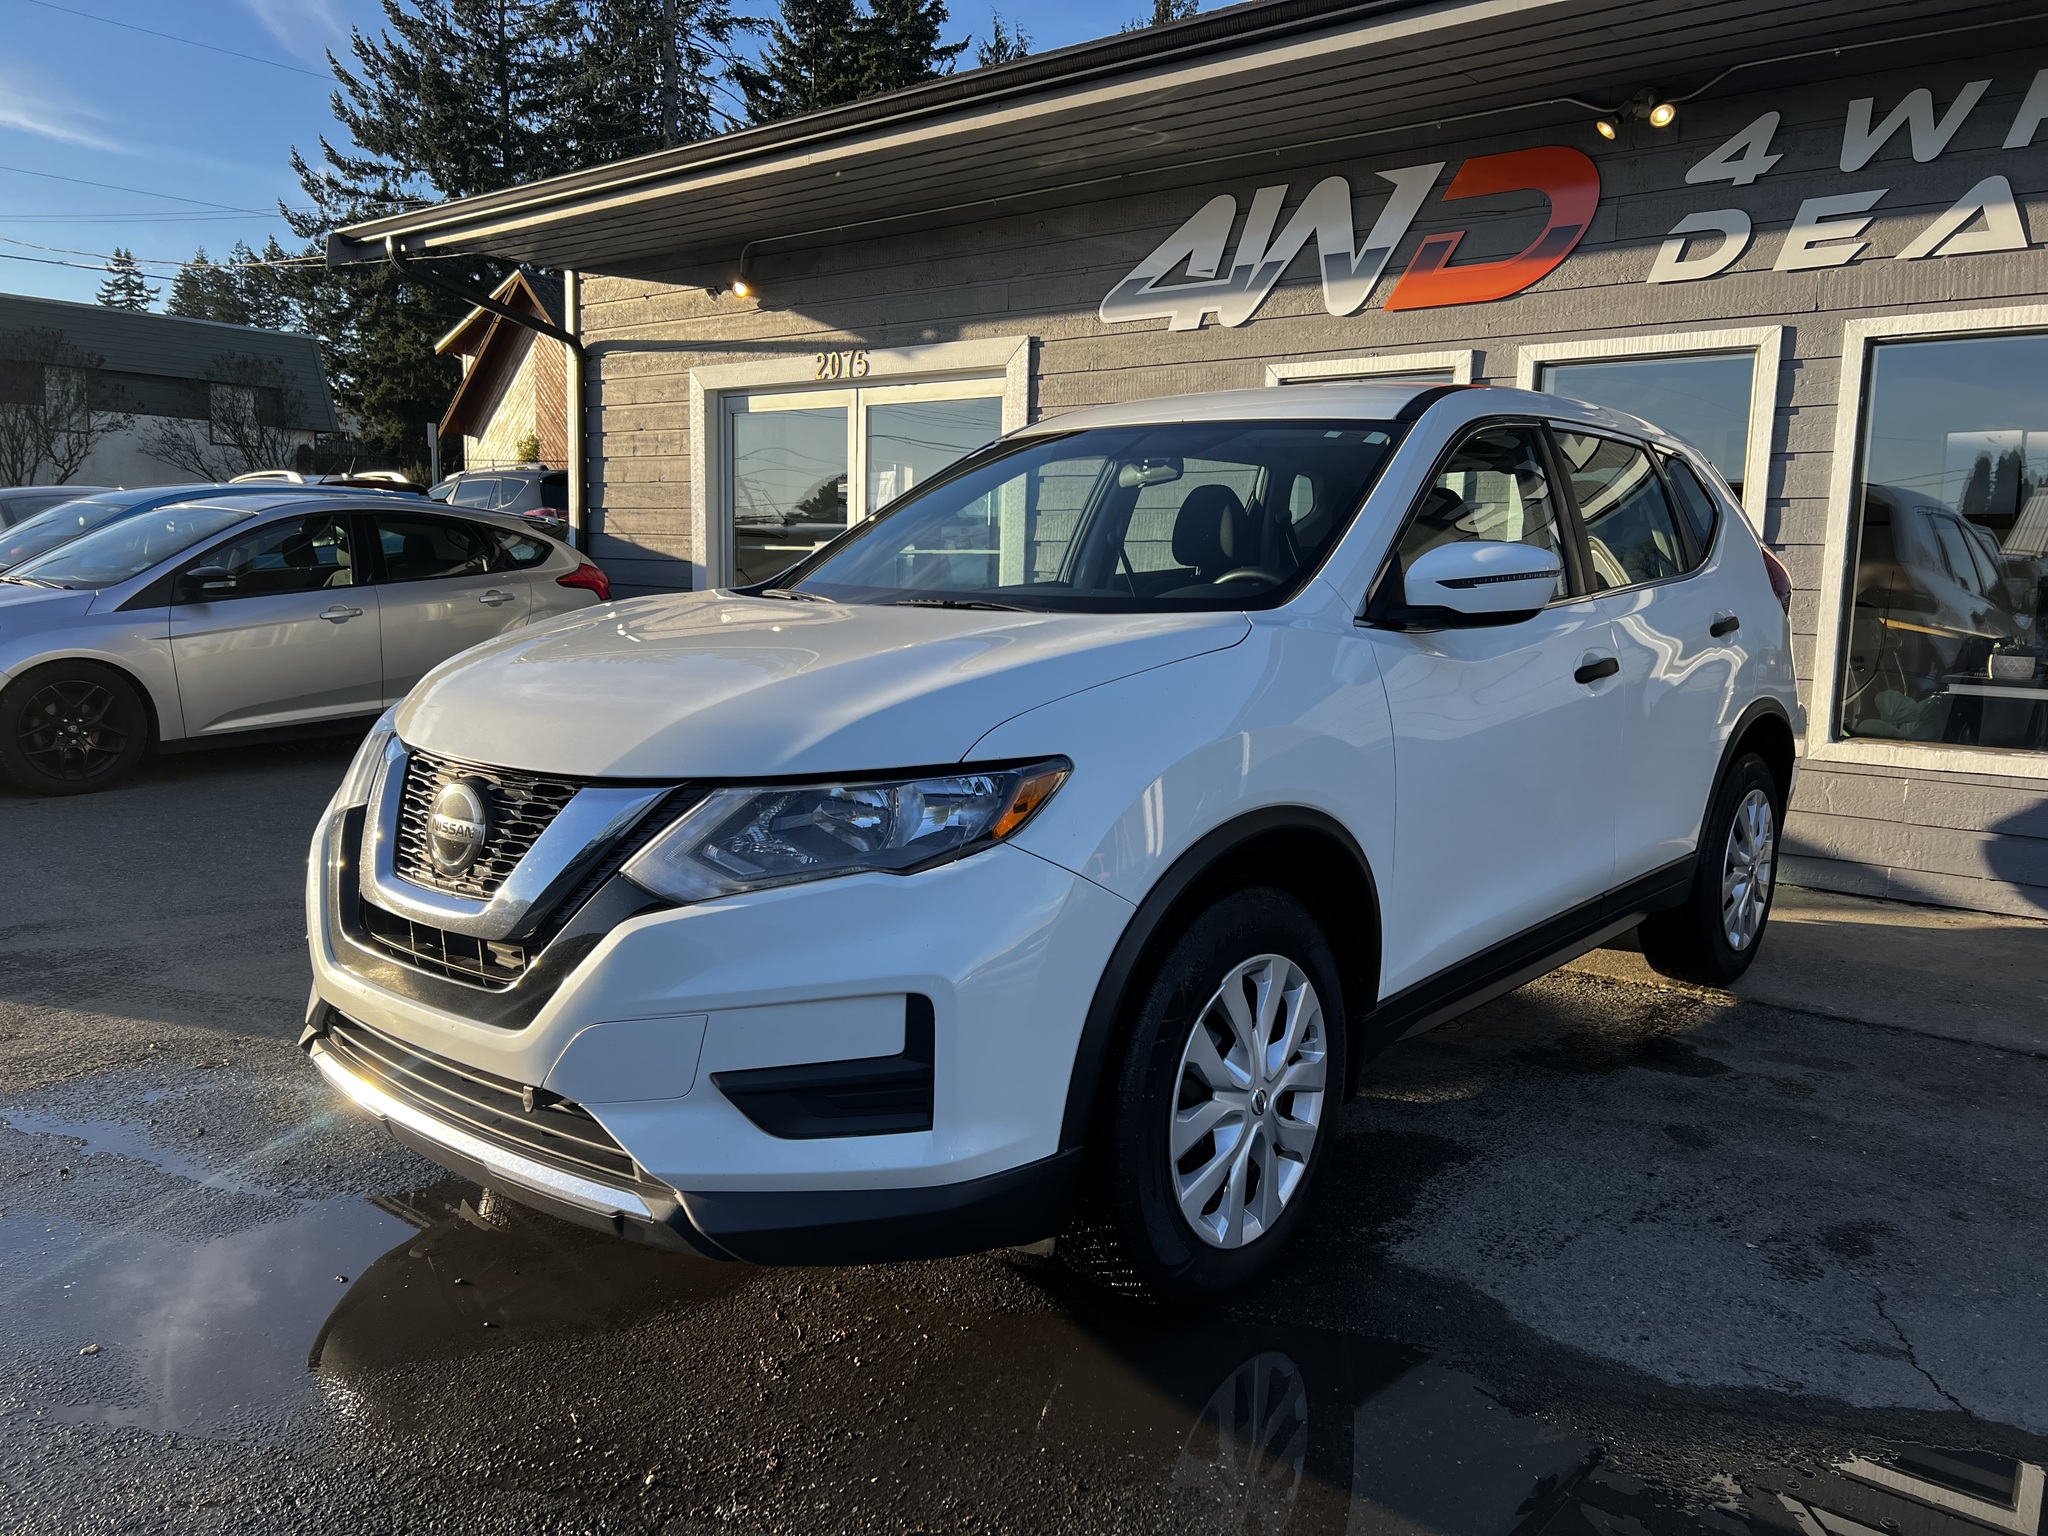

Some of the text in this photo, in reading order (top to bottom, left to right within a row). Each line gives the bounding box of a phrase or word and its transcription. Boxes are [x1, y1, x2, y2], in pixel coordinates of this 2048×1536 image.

[1684, 110, 1784, 186] 4
[1098, 145, 1601, 331] 4WD
[1645, 174, 2029, 283] DEA
[814, 349, 869, 380] 2075
[431, 818, 476, 839] NISSAN
